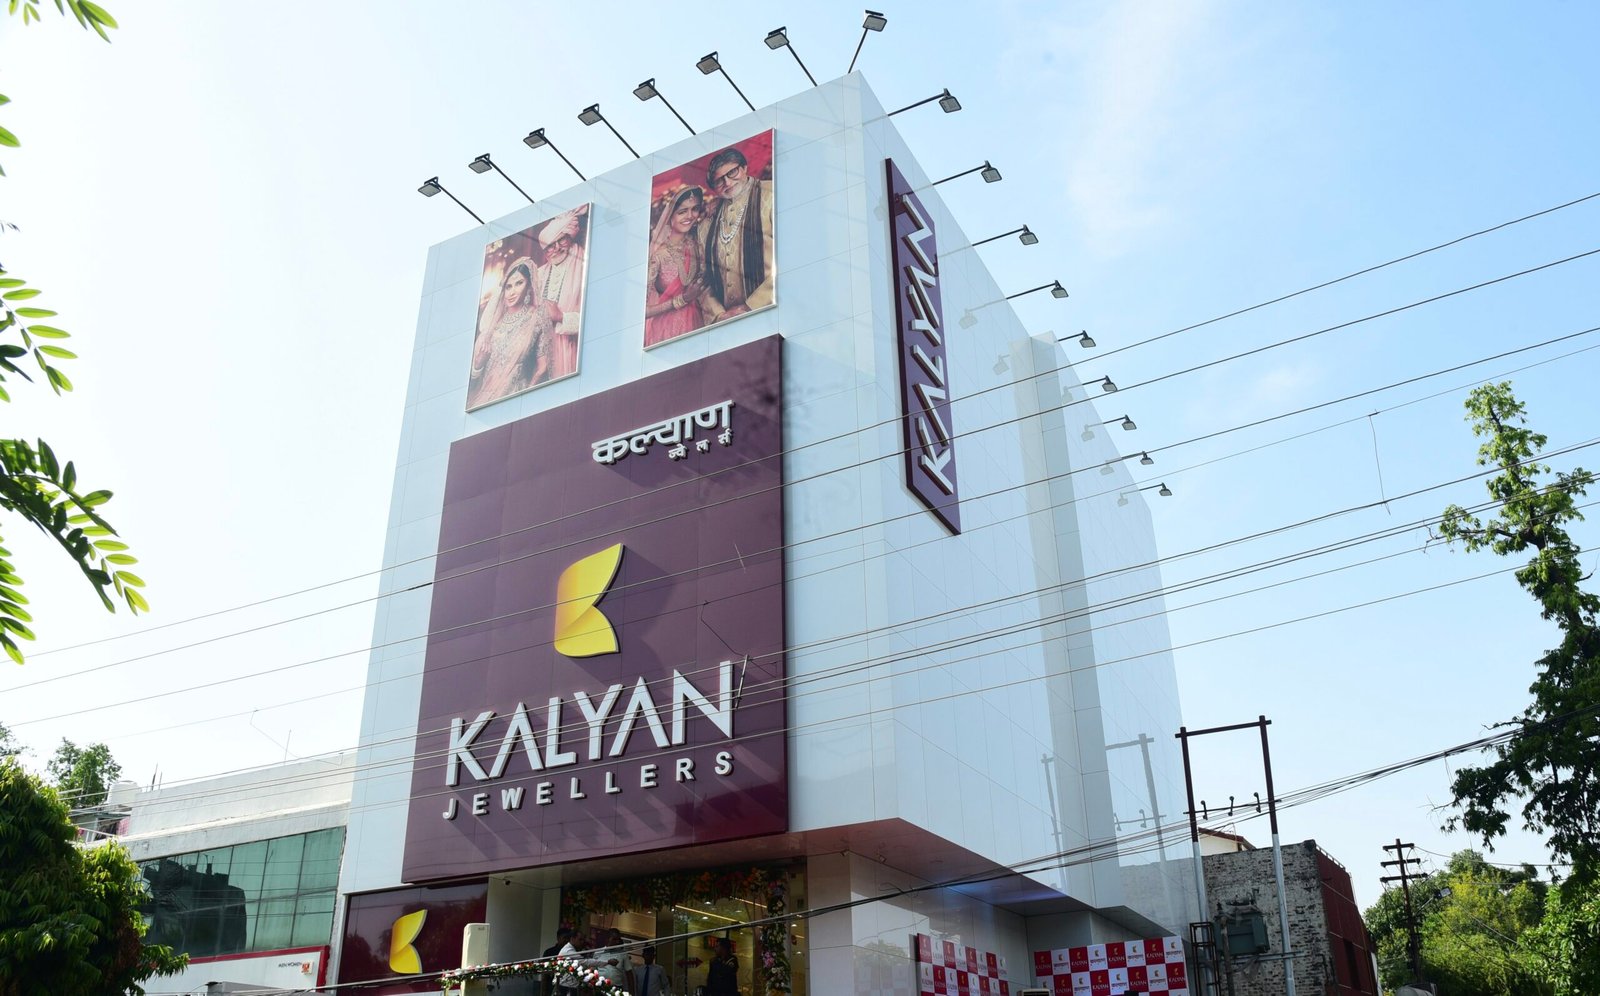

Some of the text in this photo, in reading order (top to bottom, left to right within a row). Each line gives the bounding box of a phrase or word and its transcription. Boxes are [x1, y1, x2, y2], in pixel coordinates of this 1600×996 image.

[901, 194, 954, 496] KALYAN
[591, 399, 735, 464] कल्याण
[445, 660, 733, 786] KALYAN
[442, 751, 733, 820] JEWELLERS
